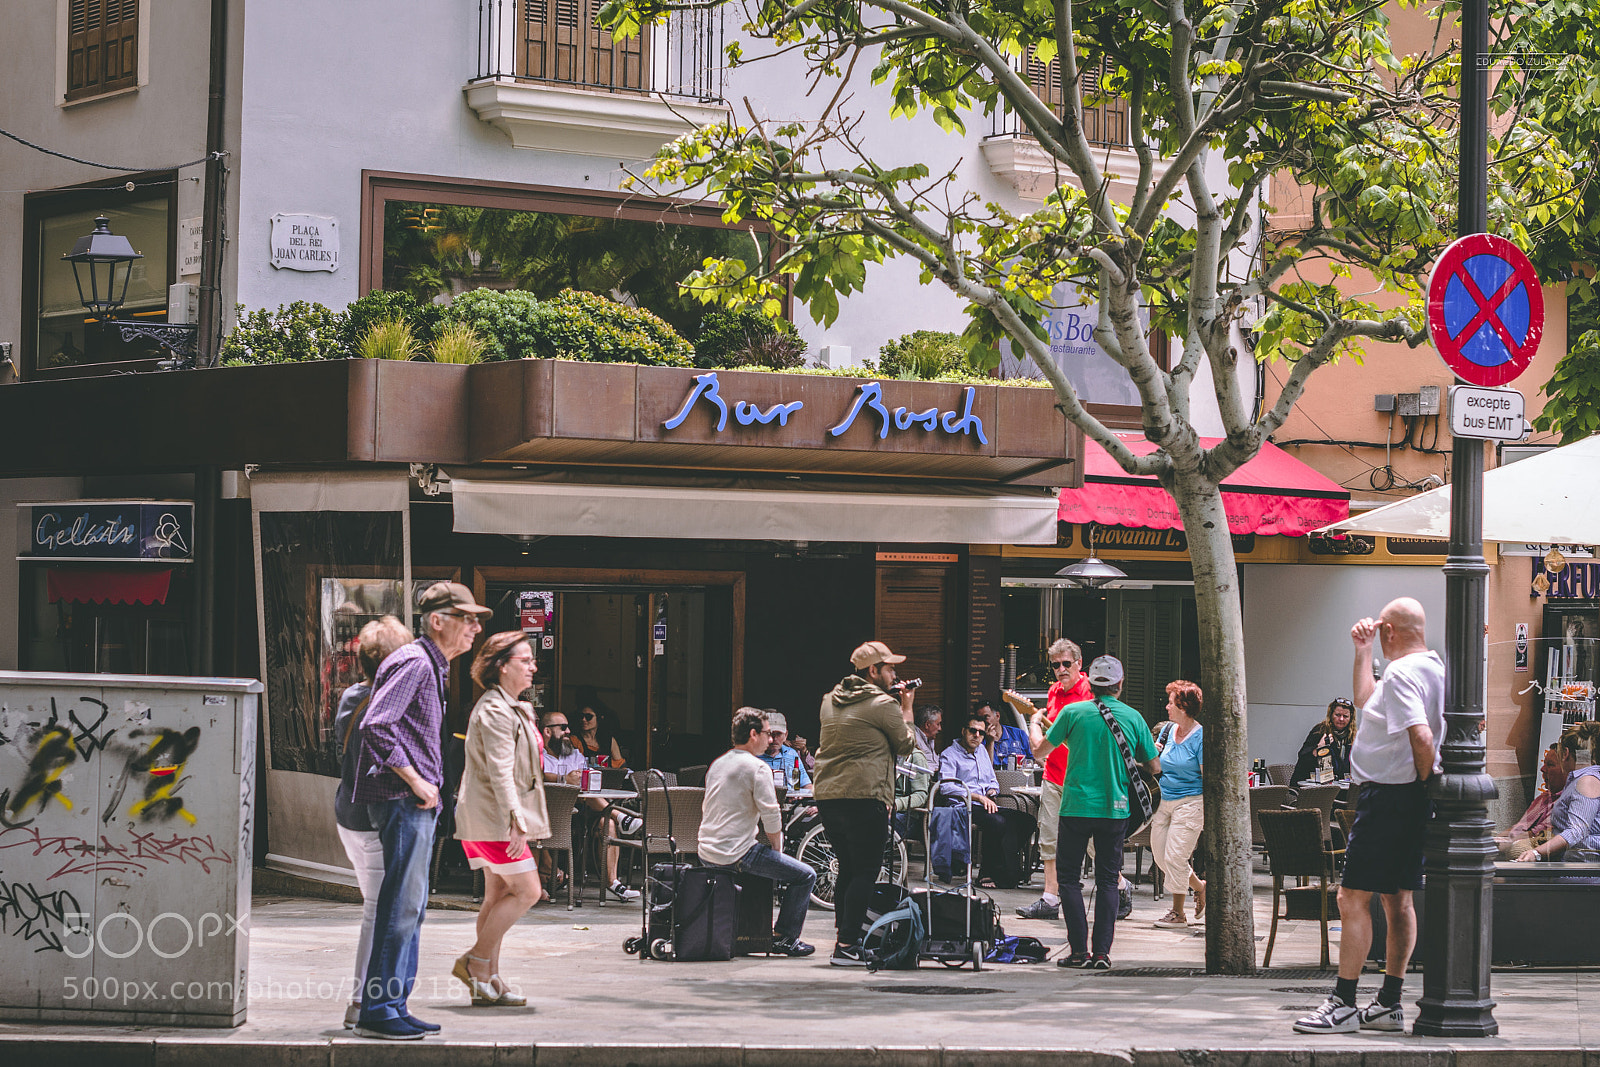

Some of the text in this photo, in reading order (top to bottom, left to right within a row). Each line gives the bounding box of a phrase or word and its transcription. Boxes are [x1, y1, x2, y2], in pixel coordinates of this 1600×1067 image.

[292, 224, 320, 238] PLAÇA
[289, 237, 323, 248] DEL REI
[274, 248, 297, 260] JOAN
[299, 249, 332, 262] CARLES
[1050, 342, 1096, 356] restaurante
[661, 371, 989, 445] Bar Bosch
[1467, 396, 1511, 411] excepte
[1463, 413, 1514, 431] bus EMT
[1088, 525, 1163, 546] Giovanni
